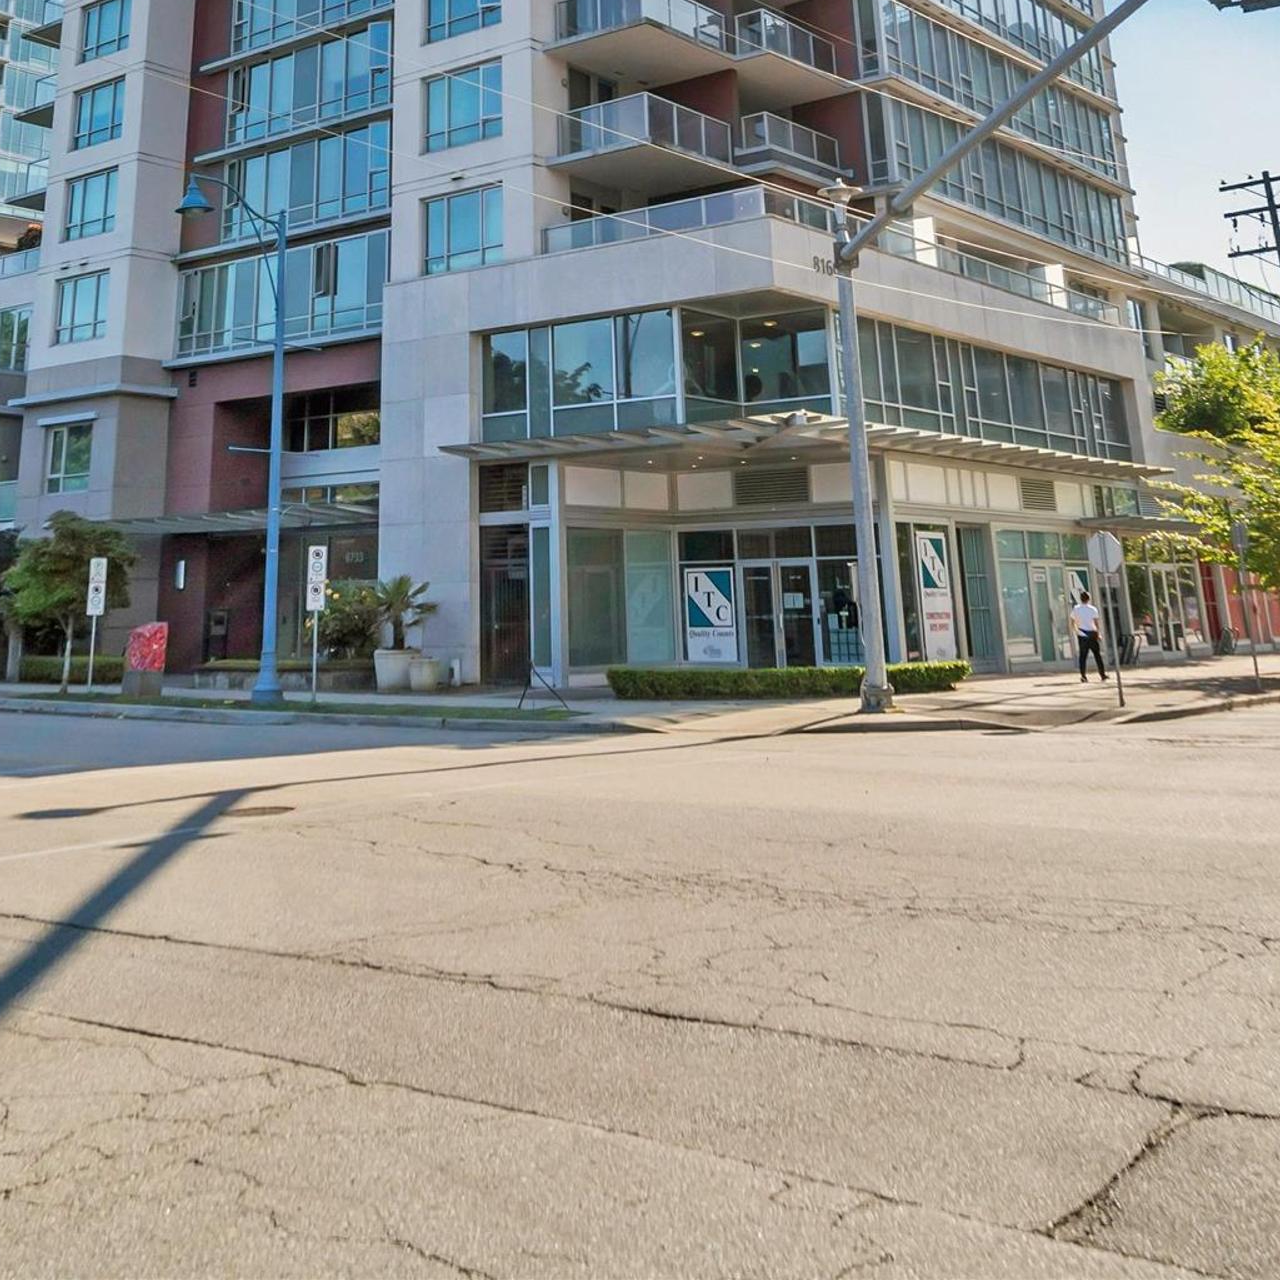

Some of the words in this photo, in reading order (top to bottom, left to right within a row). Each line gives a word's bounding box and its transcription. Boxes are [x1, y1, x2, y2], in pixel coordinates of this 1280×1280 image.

[694, 576, 729, 622] ITC
[689, 630, 710, 639] Quality
[712, 630, 734, 638] Counts
